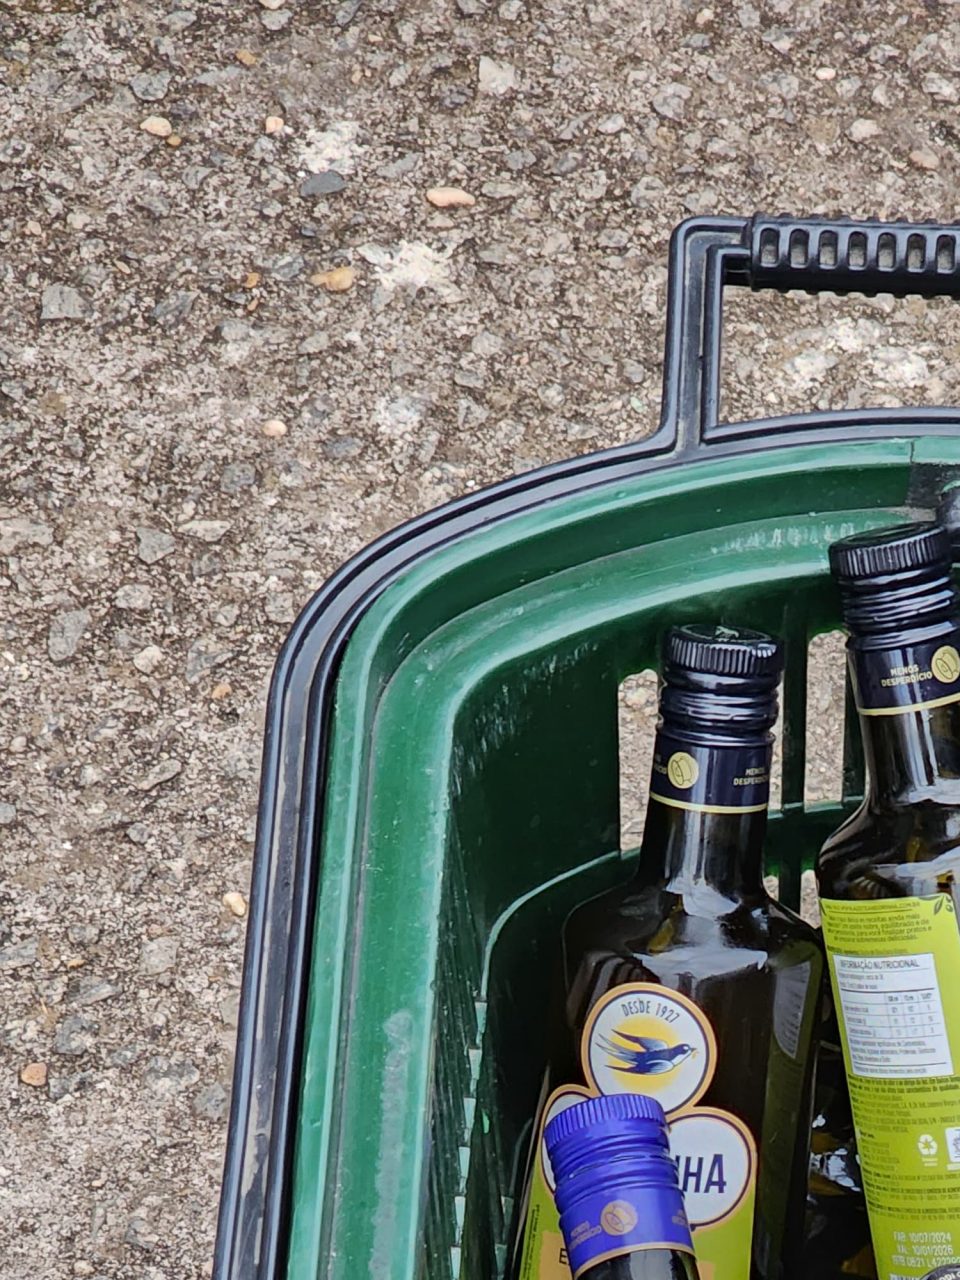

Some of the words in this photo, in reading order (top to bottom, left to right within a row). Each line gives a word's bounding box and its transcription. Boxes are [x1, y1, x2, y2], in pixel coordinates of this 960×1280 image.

[890, 664, 919, 676] MENOS
[621, 1000, 652, 1017] DESDE
[656, 1003, 680, 1023] 1927
